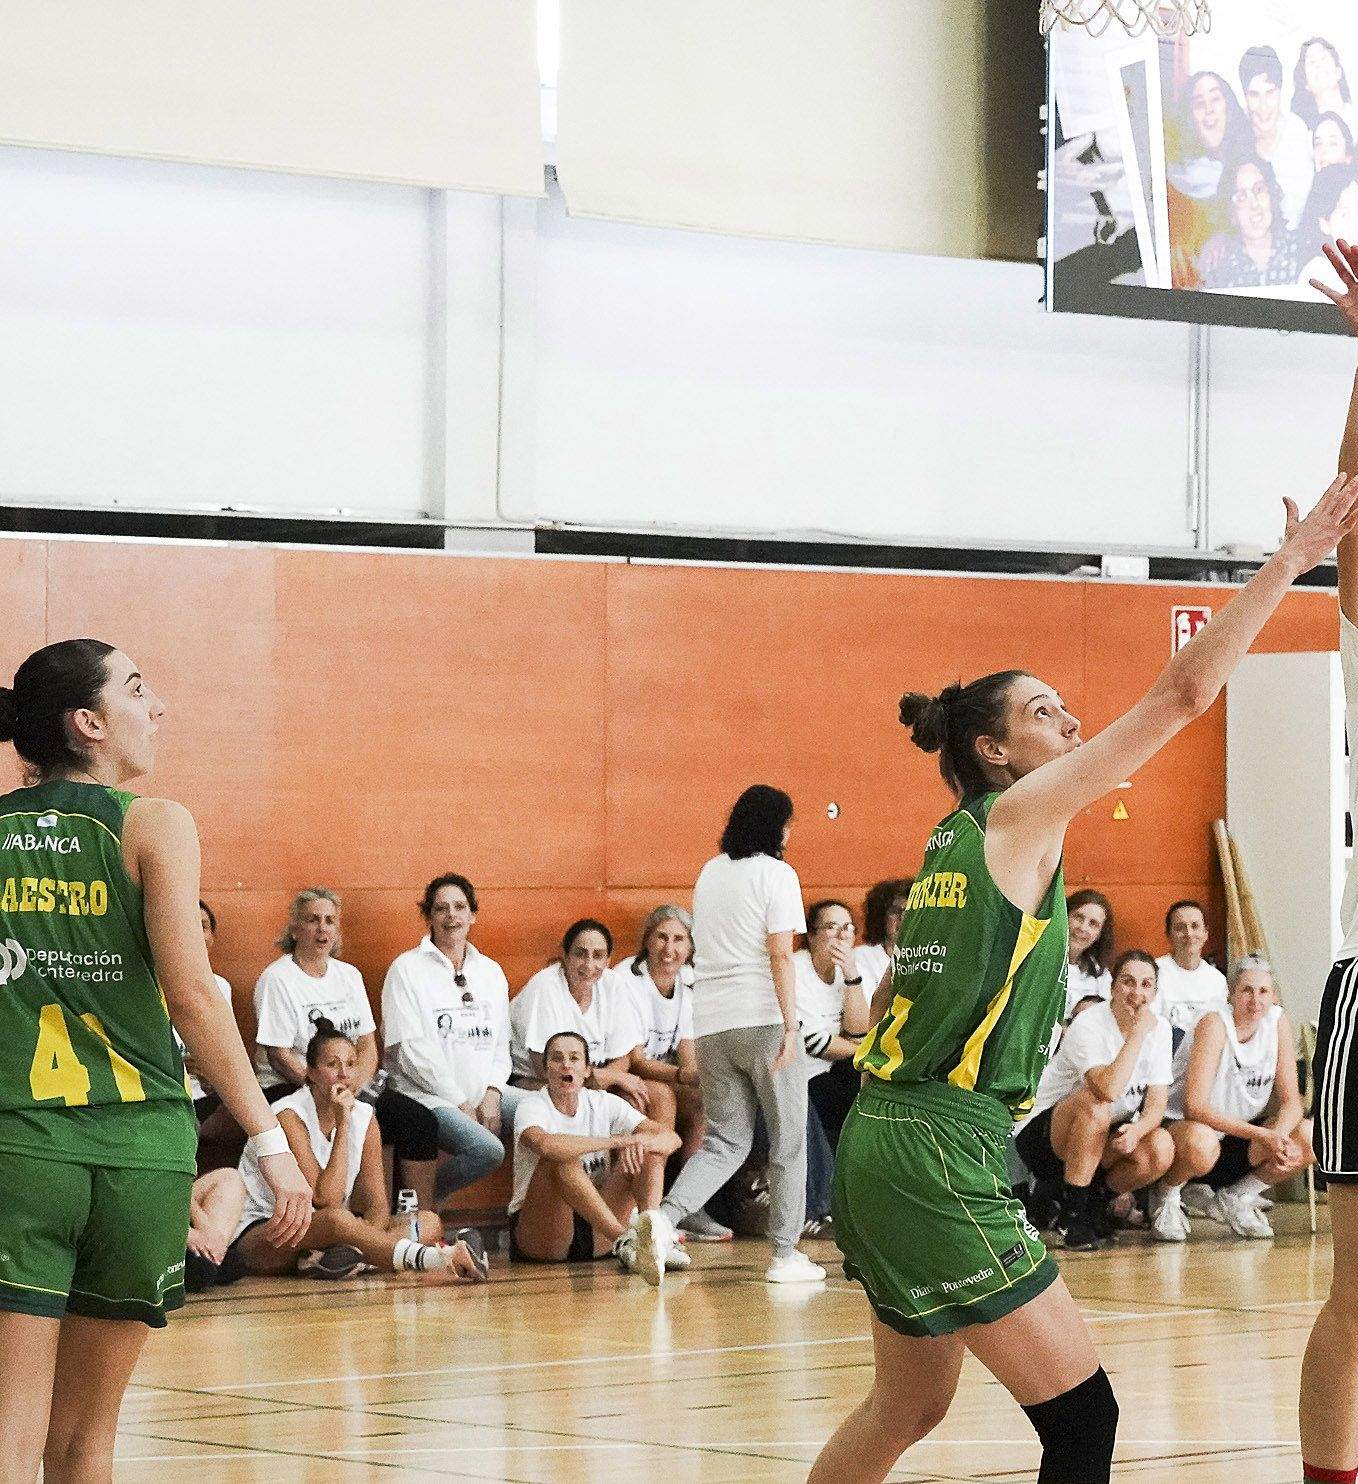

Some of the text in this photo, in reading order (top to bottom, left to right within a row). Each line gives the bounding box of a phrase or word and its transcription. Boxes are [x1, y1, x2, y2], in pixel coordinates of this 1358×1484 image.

[925, 829, 955, 852] ANCA
[0, 877, 108, 916] AESTRO
[26, 948, 122, 967] Deputación
[37, 965, 124, 982] onteedra
